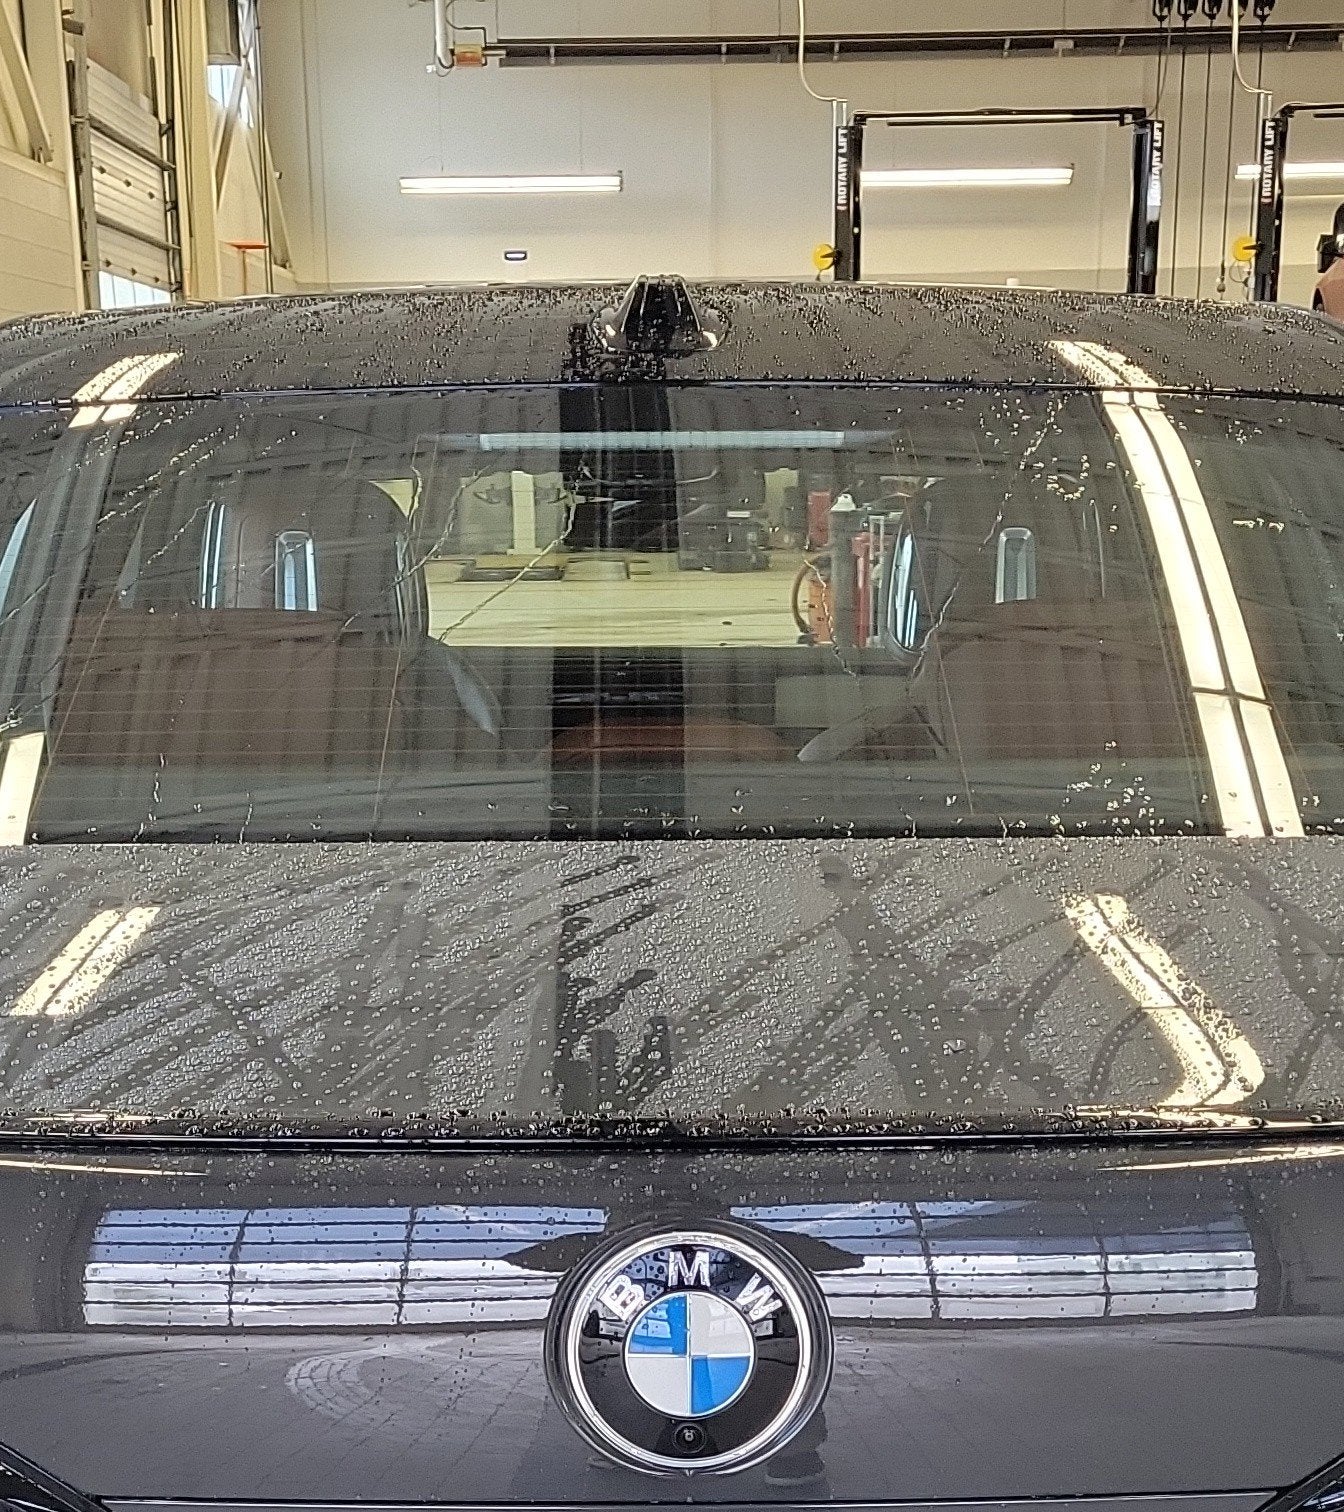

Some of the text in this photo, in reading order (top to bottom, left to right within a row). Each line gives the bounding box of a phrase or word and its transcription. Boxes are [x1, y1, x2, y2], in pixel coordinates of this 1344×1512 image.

[837, 127, 848, 204] ROTARY LIFT
[1153, 121, 1163, 147] LIFT
[1262, 120, 1276, 197] ROTARY LIFT
[598, 1250, 783, 1324] BMW
